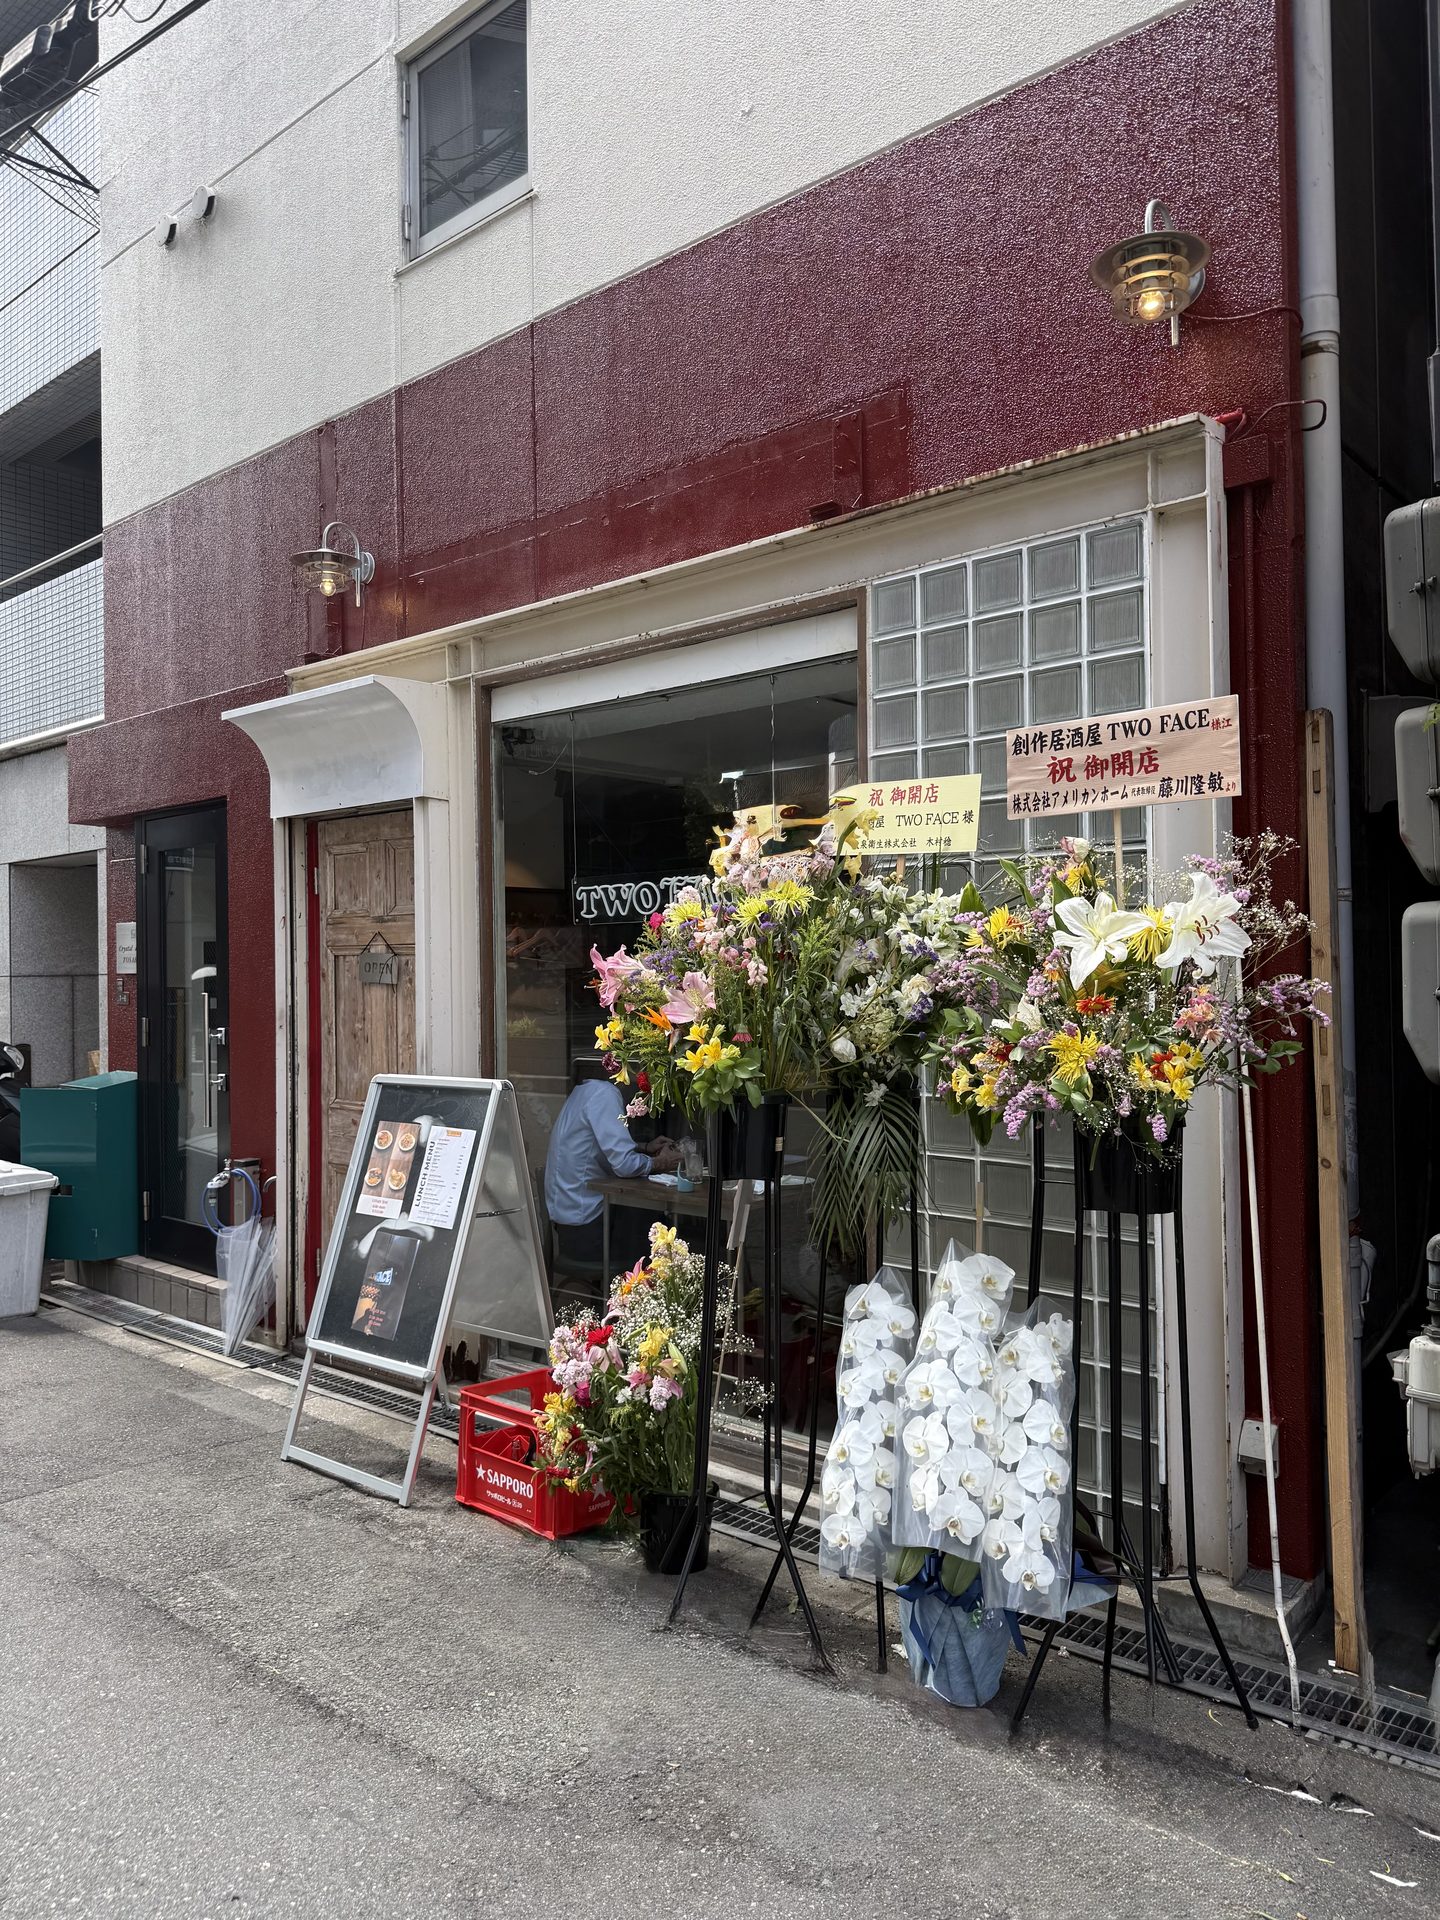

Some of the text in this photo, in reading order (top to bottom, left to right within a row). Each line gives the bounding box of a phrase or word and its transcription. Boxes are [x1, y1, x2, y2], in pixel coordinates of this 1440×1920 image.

[1012, 723, 1103, 756] 創作居酒屋
[1107, 717, 1152, 741] TWO
[1160, 708, 1211, 734] FACE
[1047, 746, 1161, 785] 祝 御開店
[868, 783, 940, 807] 祝 御開店
[1012, 784, 1128, 815] 株式会社アメリカンホーム
[1158, 771, 1225, 799] 藤川隆敏
[896, 813, 923, 827] TWO
[925, 811, 959, 826] FACE
[961, 809, 975, 824] 様
[576, 881, 661, 919] TWO
[364, 961, 393, 975] OPEN
[415, 1141, 436, 1207] LUNCH MENU
[487, 1469, 534, 1499] SAPPORO
